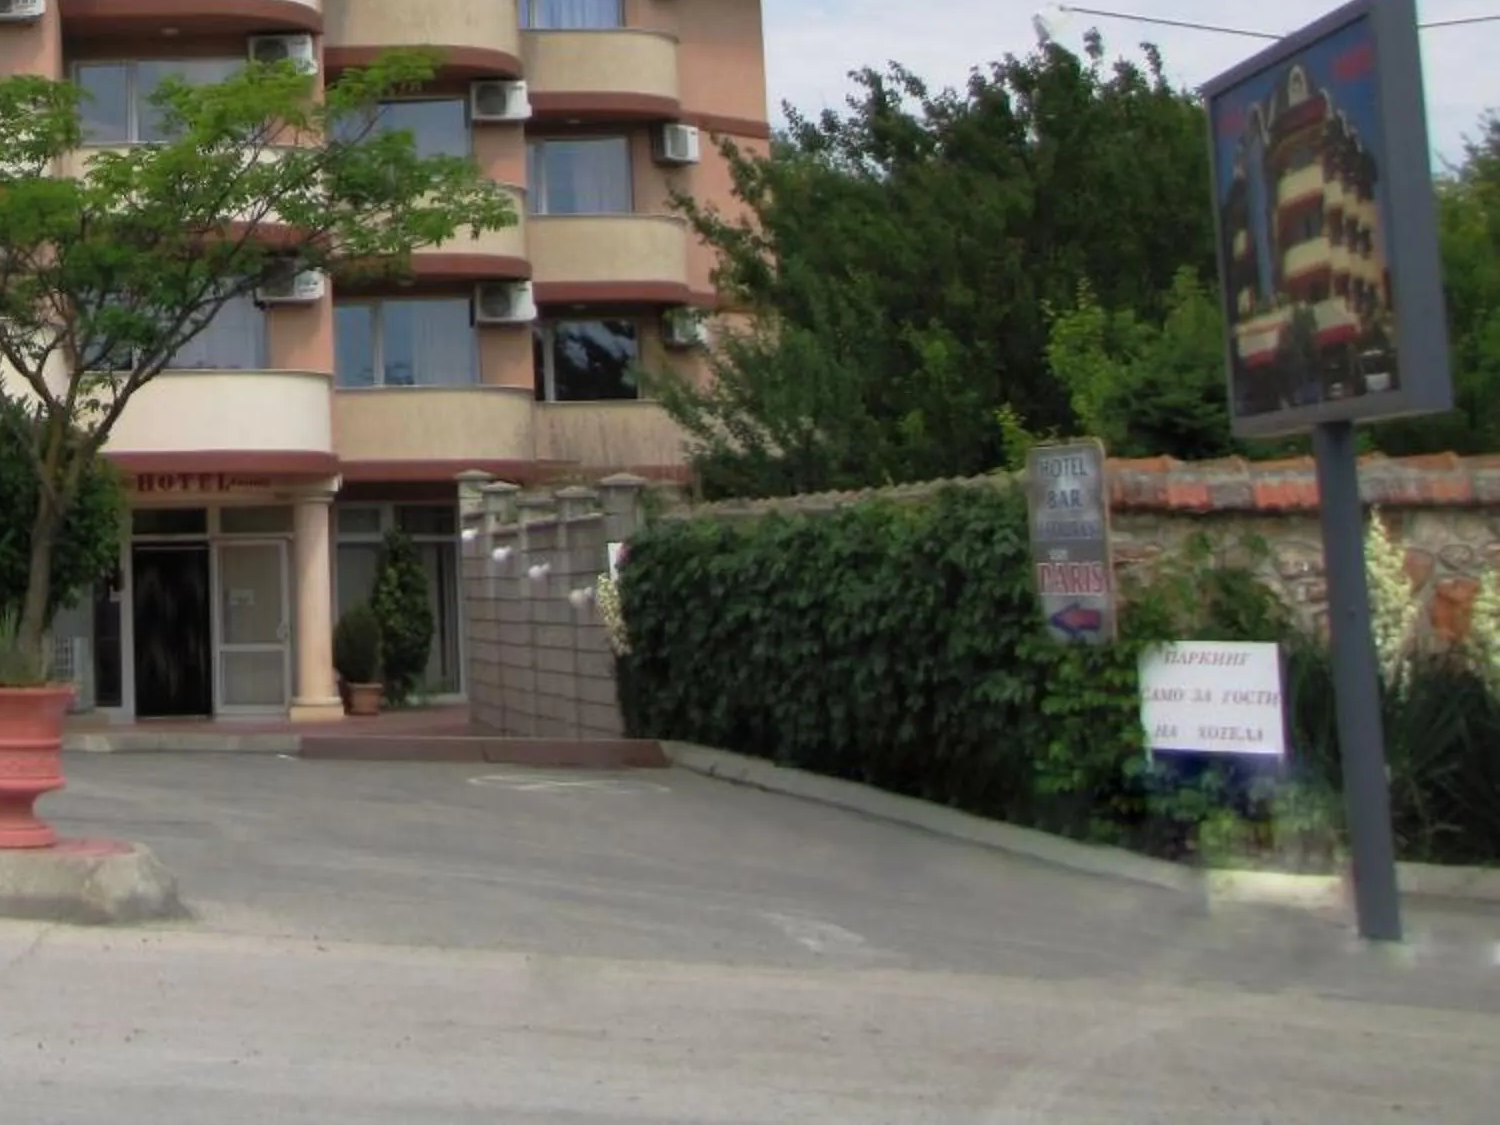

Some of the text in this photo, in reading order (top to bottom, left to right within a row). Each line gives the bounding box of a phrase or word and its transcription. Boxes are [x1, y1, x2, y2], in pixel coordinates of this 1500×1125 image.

[1040, 457, 1088, 478] HOTEL
[1046, 489, 1084, 510] BAR
[1039, 564, 1108, 593] PARIS
[1164, 650, 1251, 666] ПАРКИНГ
